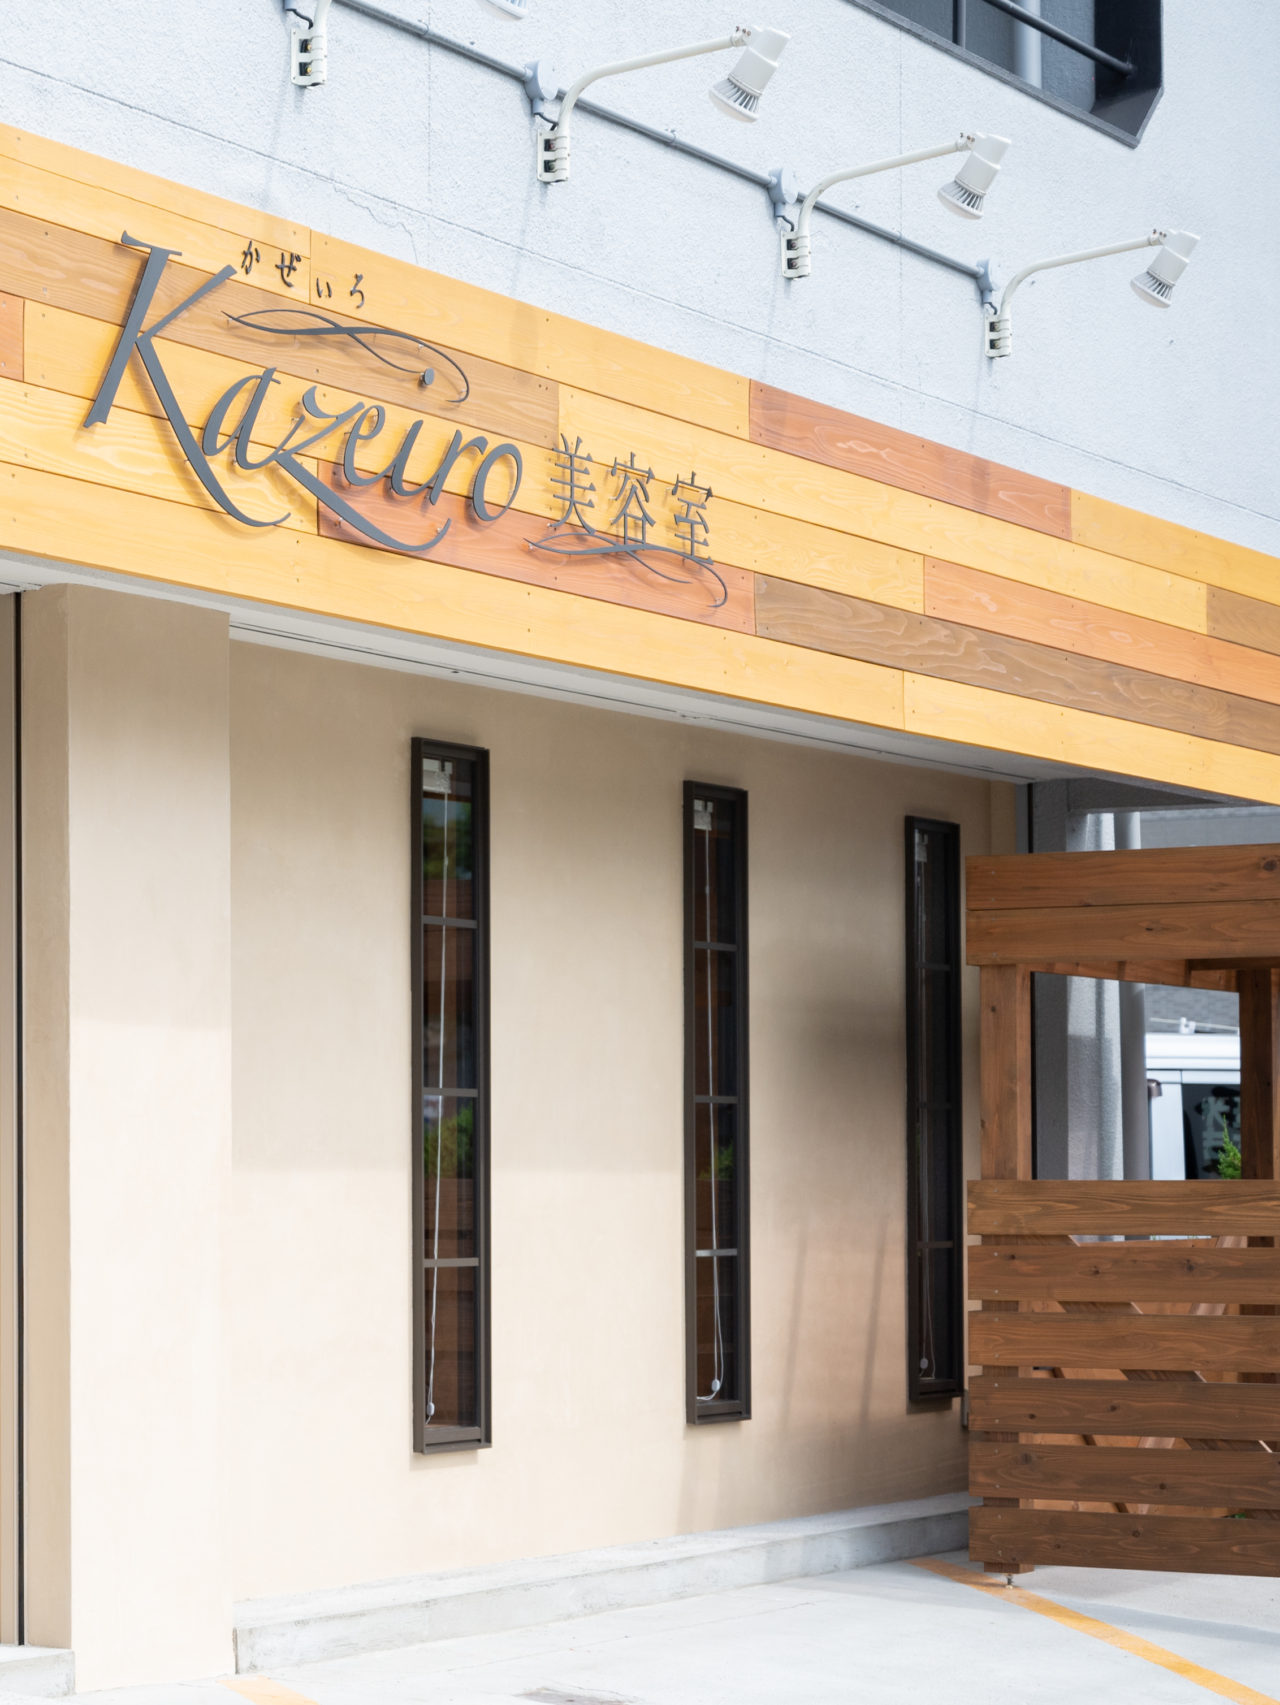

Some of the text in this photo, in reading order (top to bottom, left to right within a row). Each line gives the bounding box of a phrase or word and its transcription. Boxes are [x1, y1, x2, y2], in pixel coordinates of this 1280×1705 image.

[241, 240, 365, 309] かぜいろ
[548, 433, 715, 565] 美容室
